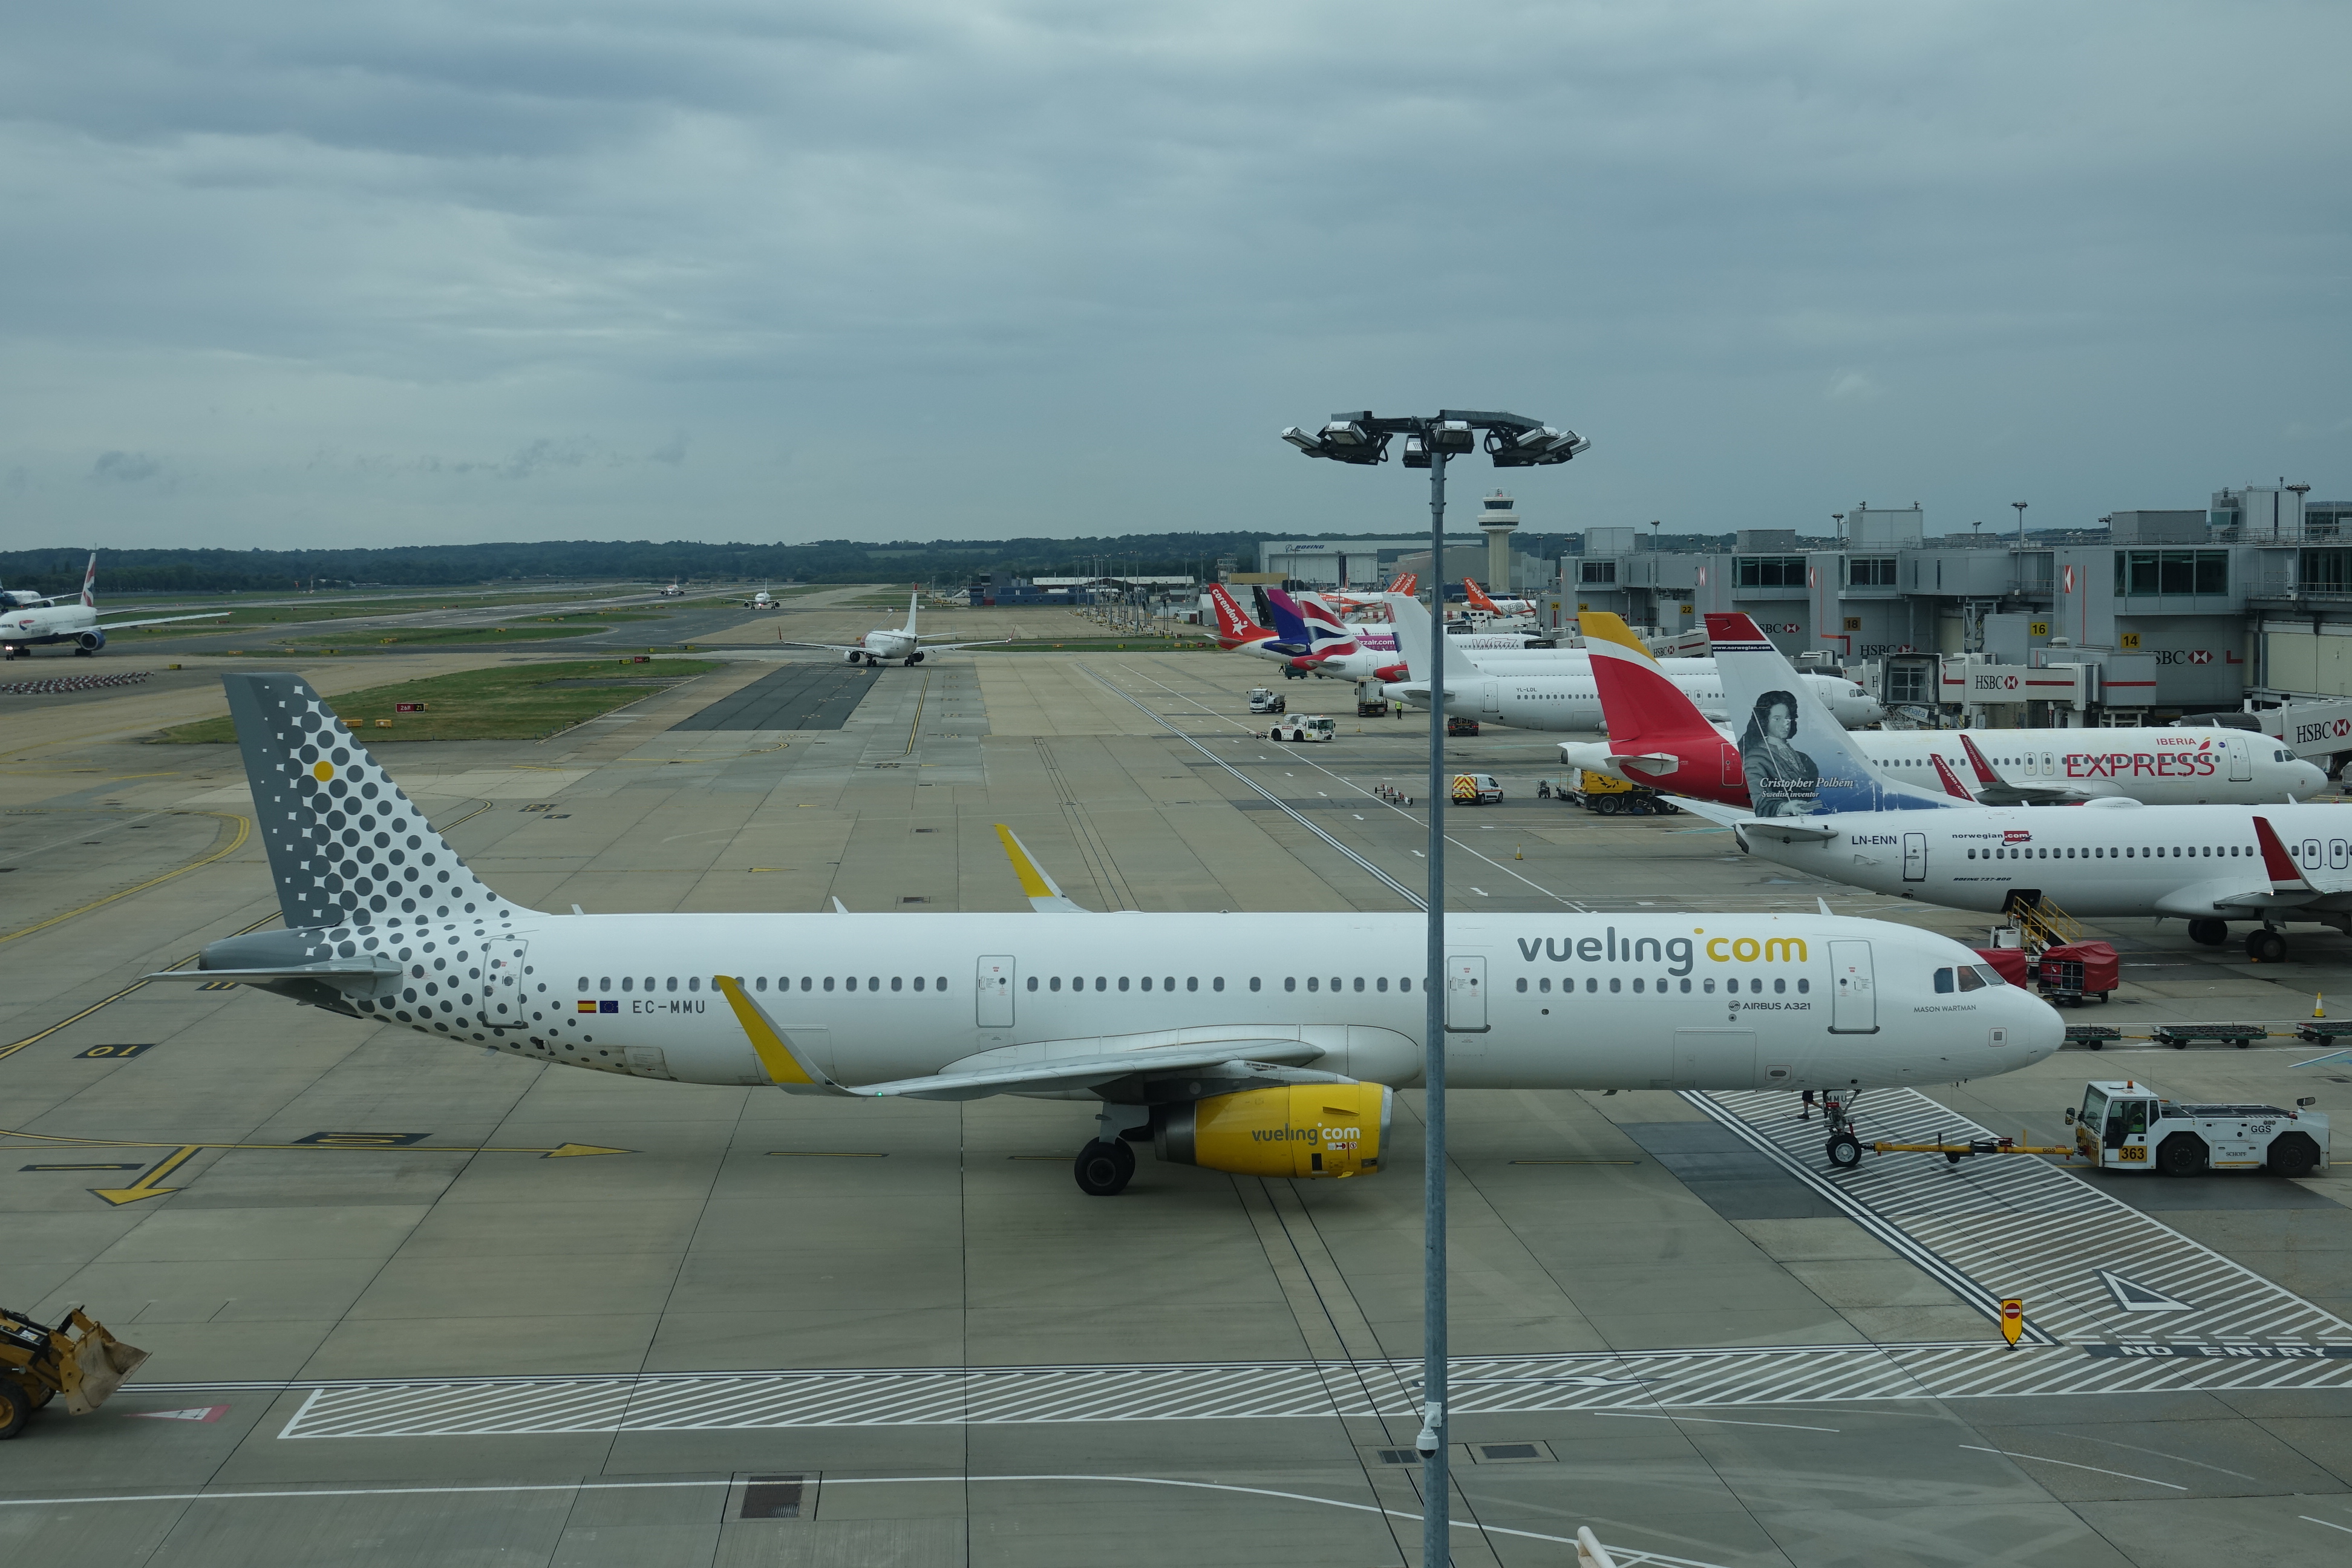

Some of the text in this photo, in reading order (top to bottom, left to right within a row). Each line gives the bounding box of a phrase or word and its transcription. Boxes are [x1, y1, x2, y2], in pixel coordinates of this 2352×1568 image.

[1391, 573, 1406, 592] easyJet
[1465, 578, 1485, 600] easyJet
[1212, 588, 1240, 623] corendon
[1757, 623, 1782, 633] SBC
[1846, 619, 1858, 629] 18
[2032, 624, 2046, 634] 16
[2123, 635, 2138, 646] 14
[1653, 647, 1667, 658] HSBC
[1859, 644, 1896, 656] HSBC
[2153, 650, 2186, 665] SBC
[1975, 675, 2003, 690] HSBC
[2296, 720, 2332, 744] HSBC
[1963, 737, 1984, 770] iberiaexpress.com
[2066, 752, 2215, 777] EXPRESS
[1760, 777, 1854, 791] Cristopher Polhem
[1935, 756, 1968, 799] norwegian.com
[1852, 835, 1897, 845] LN-ENN
[632, 1000, 705, 1014] EC-MMU
[2121, 1147, 2145, 1160] 363
[2119, 1346, 2326, 1357] NO ENTRY
